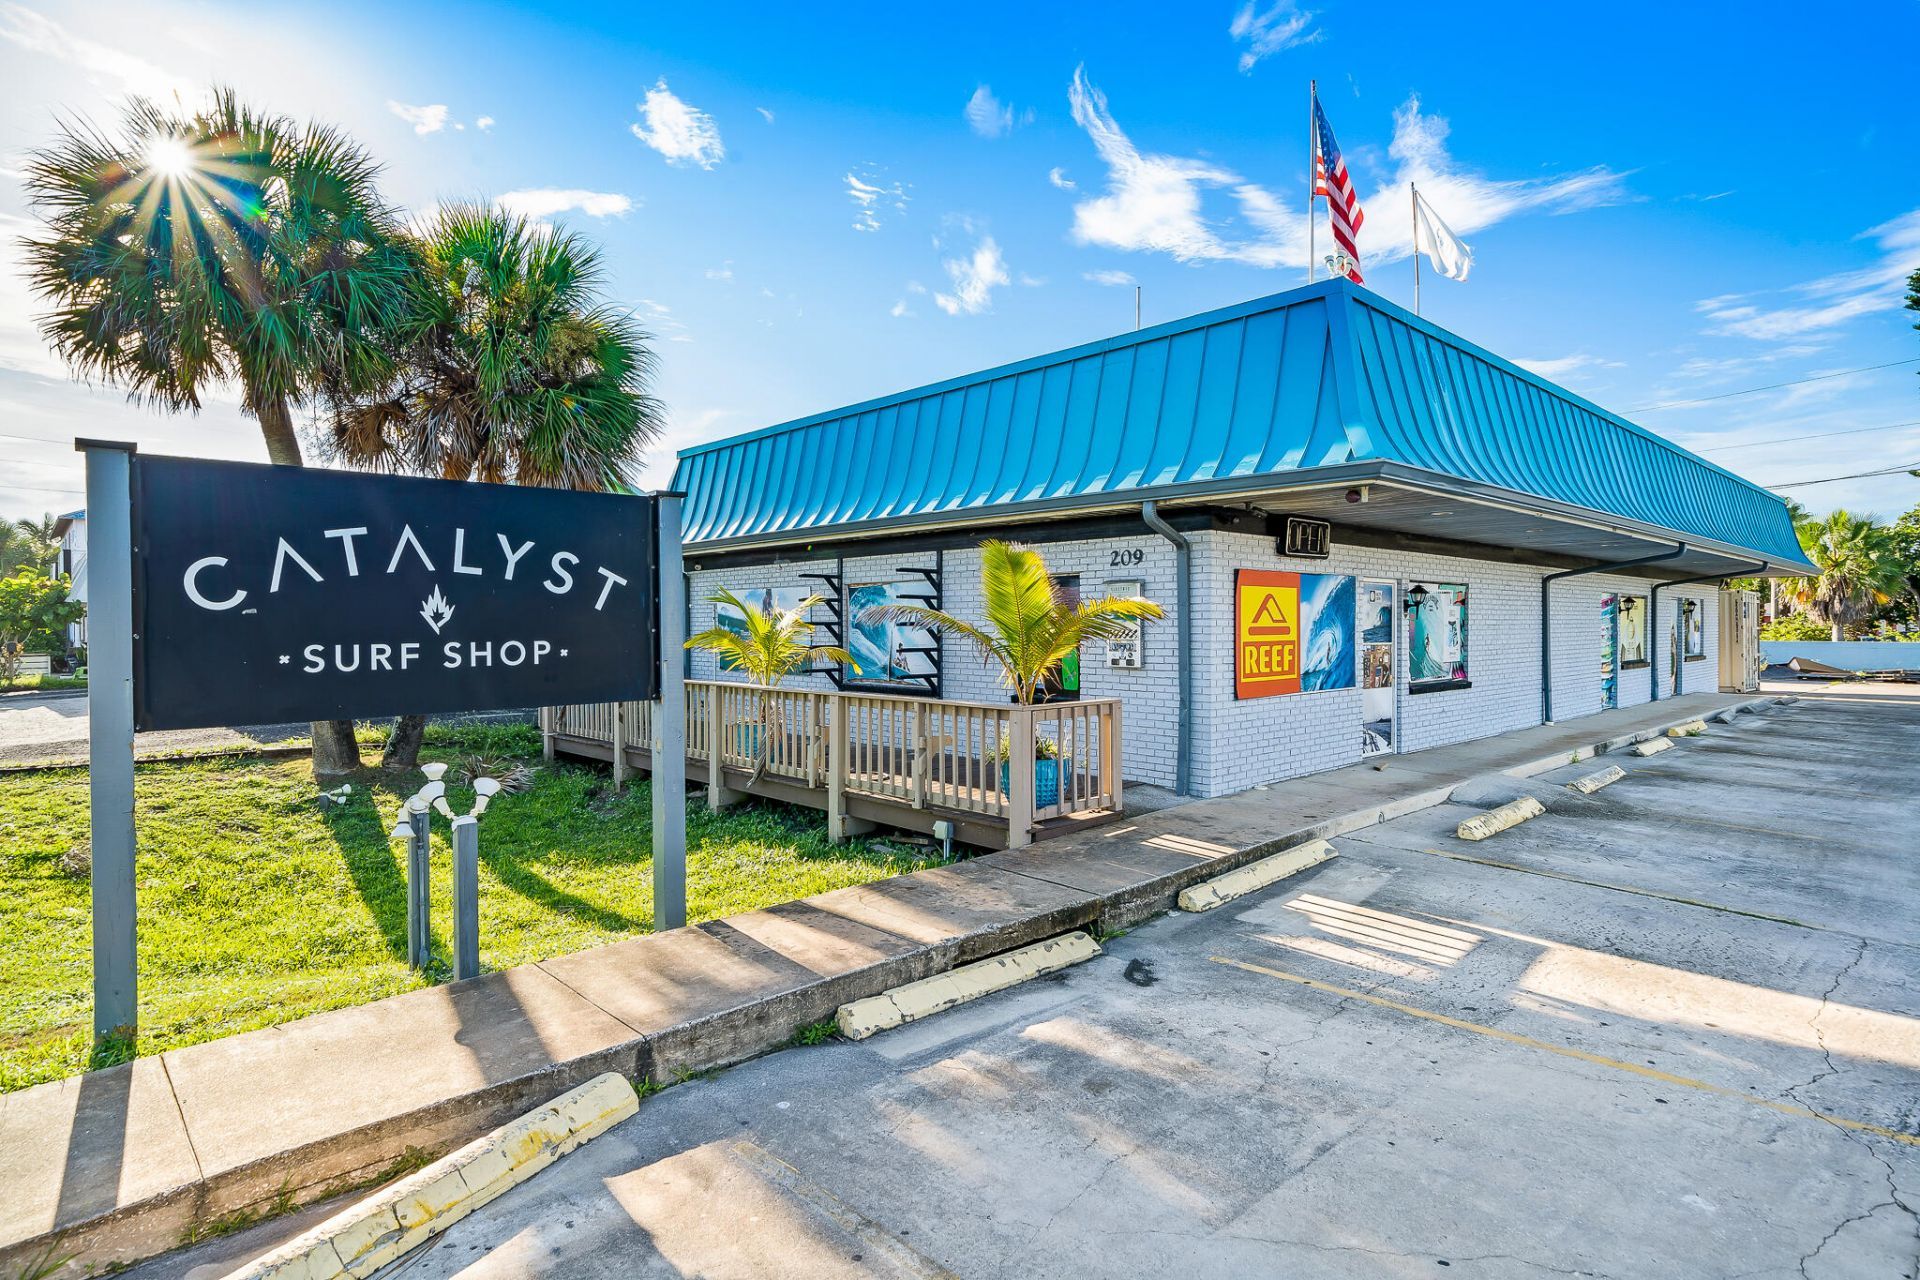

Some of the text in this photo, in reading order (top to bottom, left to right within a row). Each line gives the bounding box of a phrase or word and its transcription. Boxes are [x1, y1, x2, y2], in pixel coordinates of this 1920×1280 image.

[1288, 522, 1328, 554] OPEN
[183, 523, 628, 612] CATALYST
[1110, 549, 1143, 567] 209
[303, 639, 552, 674] SURF SHOP
[1244, 643, 1294, 674] REEF
